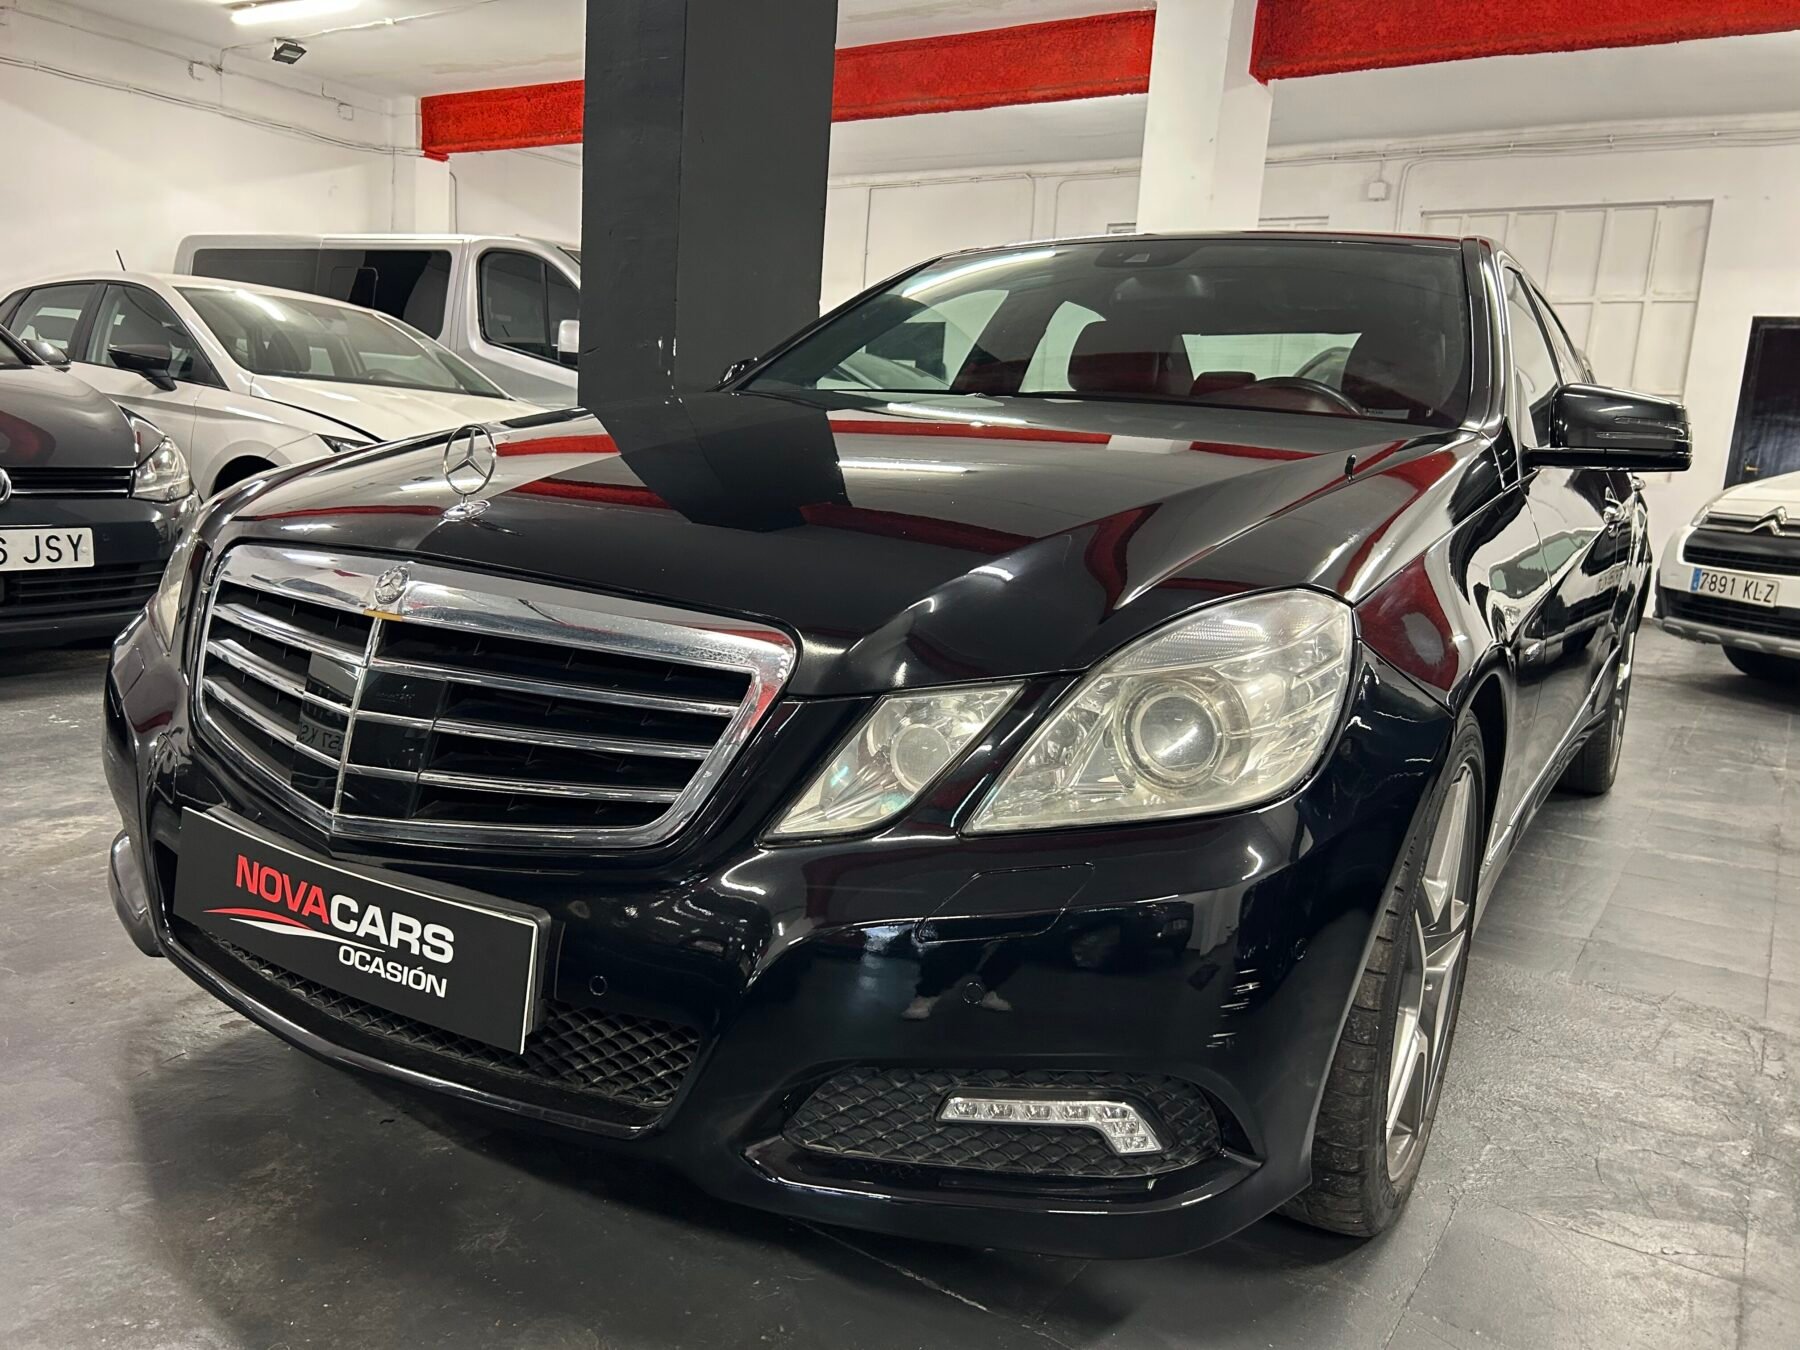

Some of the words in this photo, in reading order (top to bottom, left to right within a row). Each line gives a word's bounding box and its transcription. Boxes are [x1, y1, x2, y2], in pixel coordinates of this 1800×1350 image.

[23, 534, 82, 563] JSY
[1700, 573, 1736, 596] 7891
[1742, 580, 1775, 603] KLZ
[235, 854, 455, 964] NOVACARS
[338, 944, 447, 998] OCASIÓN
